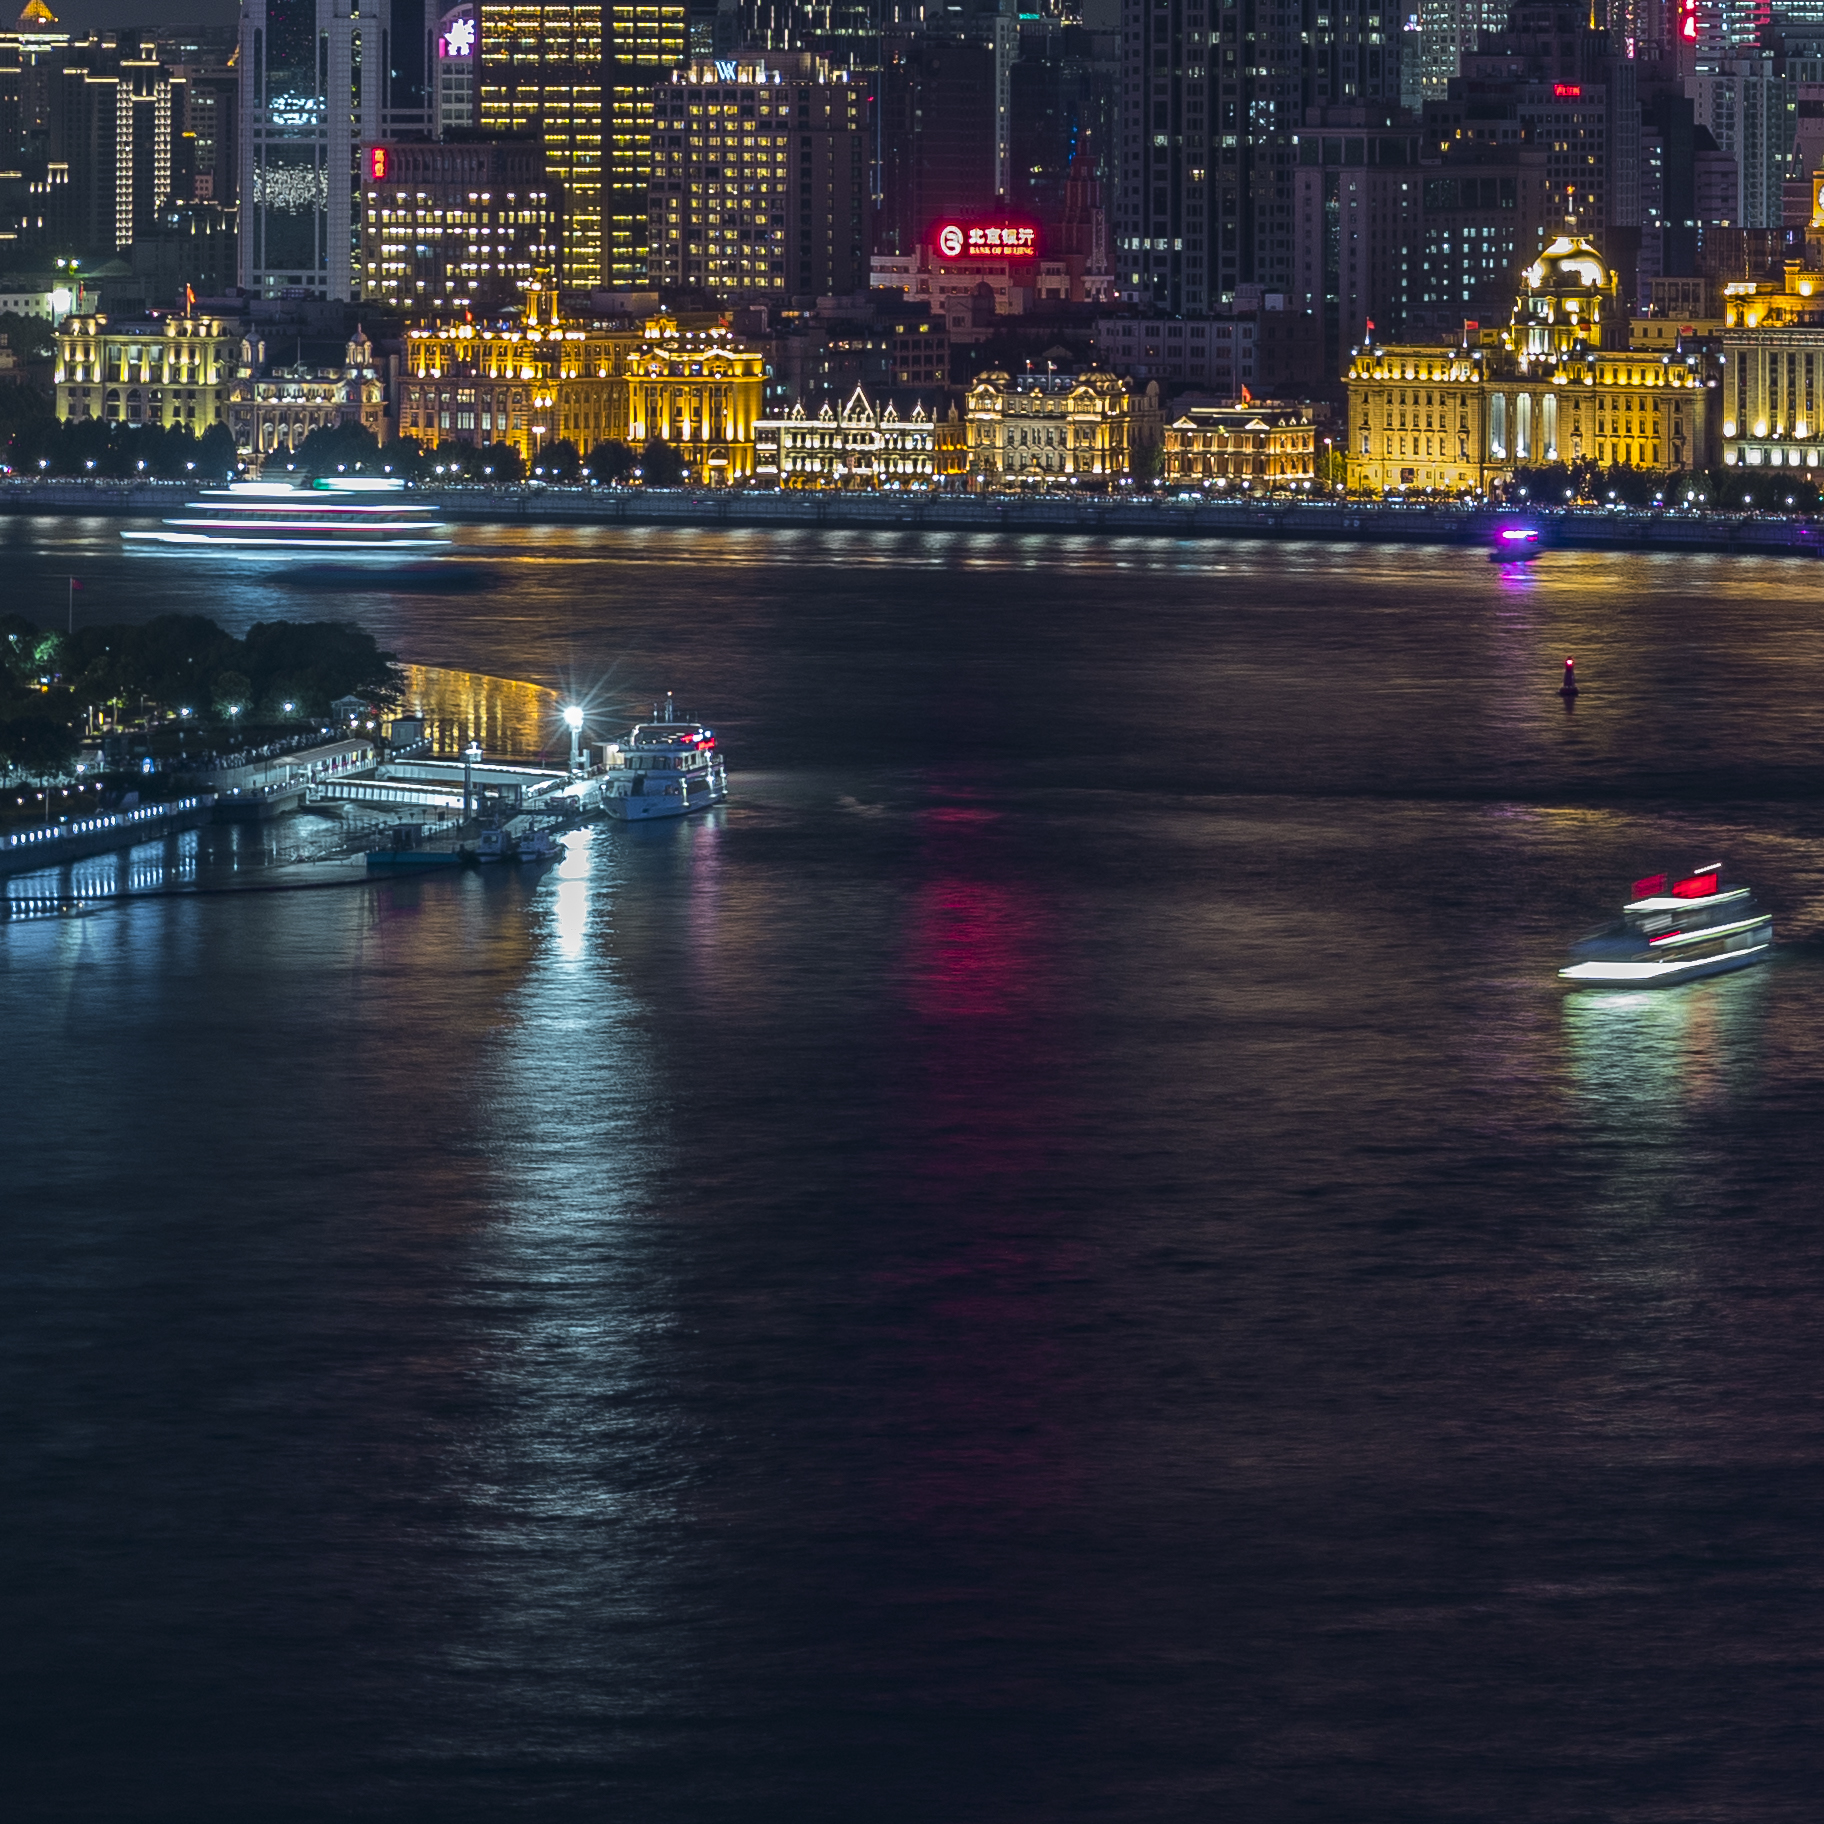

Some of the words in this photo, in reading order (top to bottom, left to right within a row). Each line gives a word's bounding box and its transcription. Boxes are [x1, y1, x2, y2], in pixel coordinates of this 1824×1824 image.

[968, 227, 1035, 245] 北京银行
[969, 246, 990, 255] BANK
[992, 246, 1002, 255] OF
